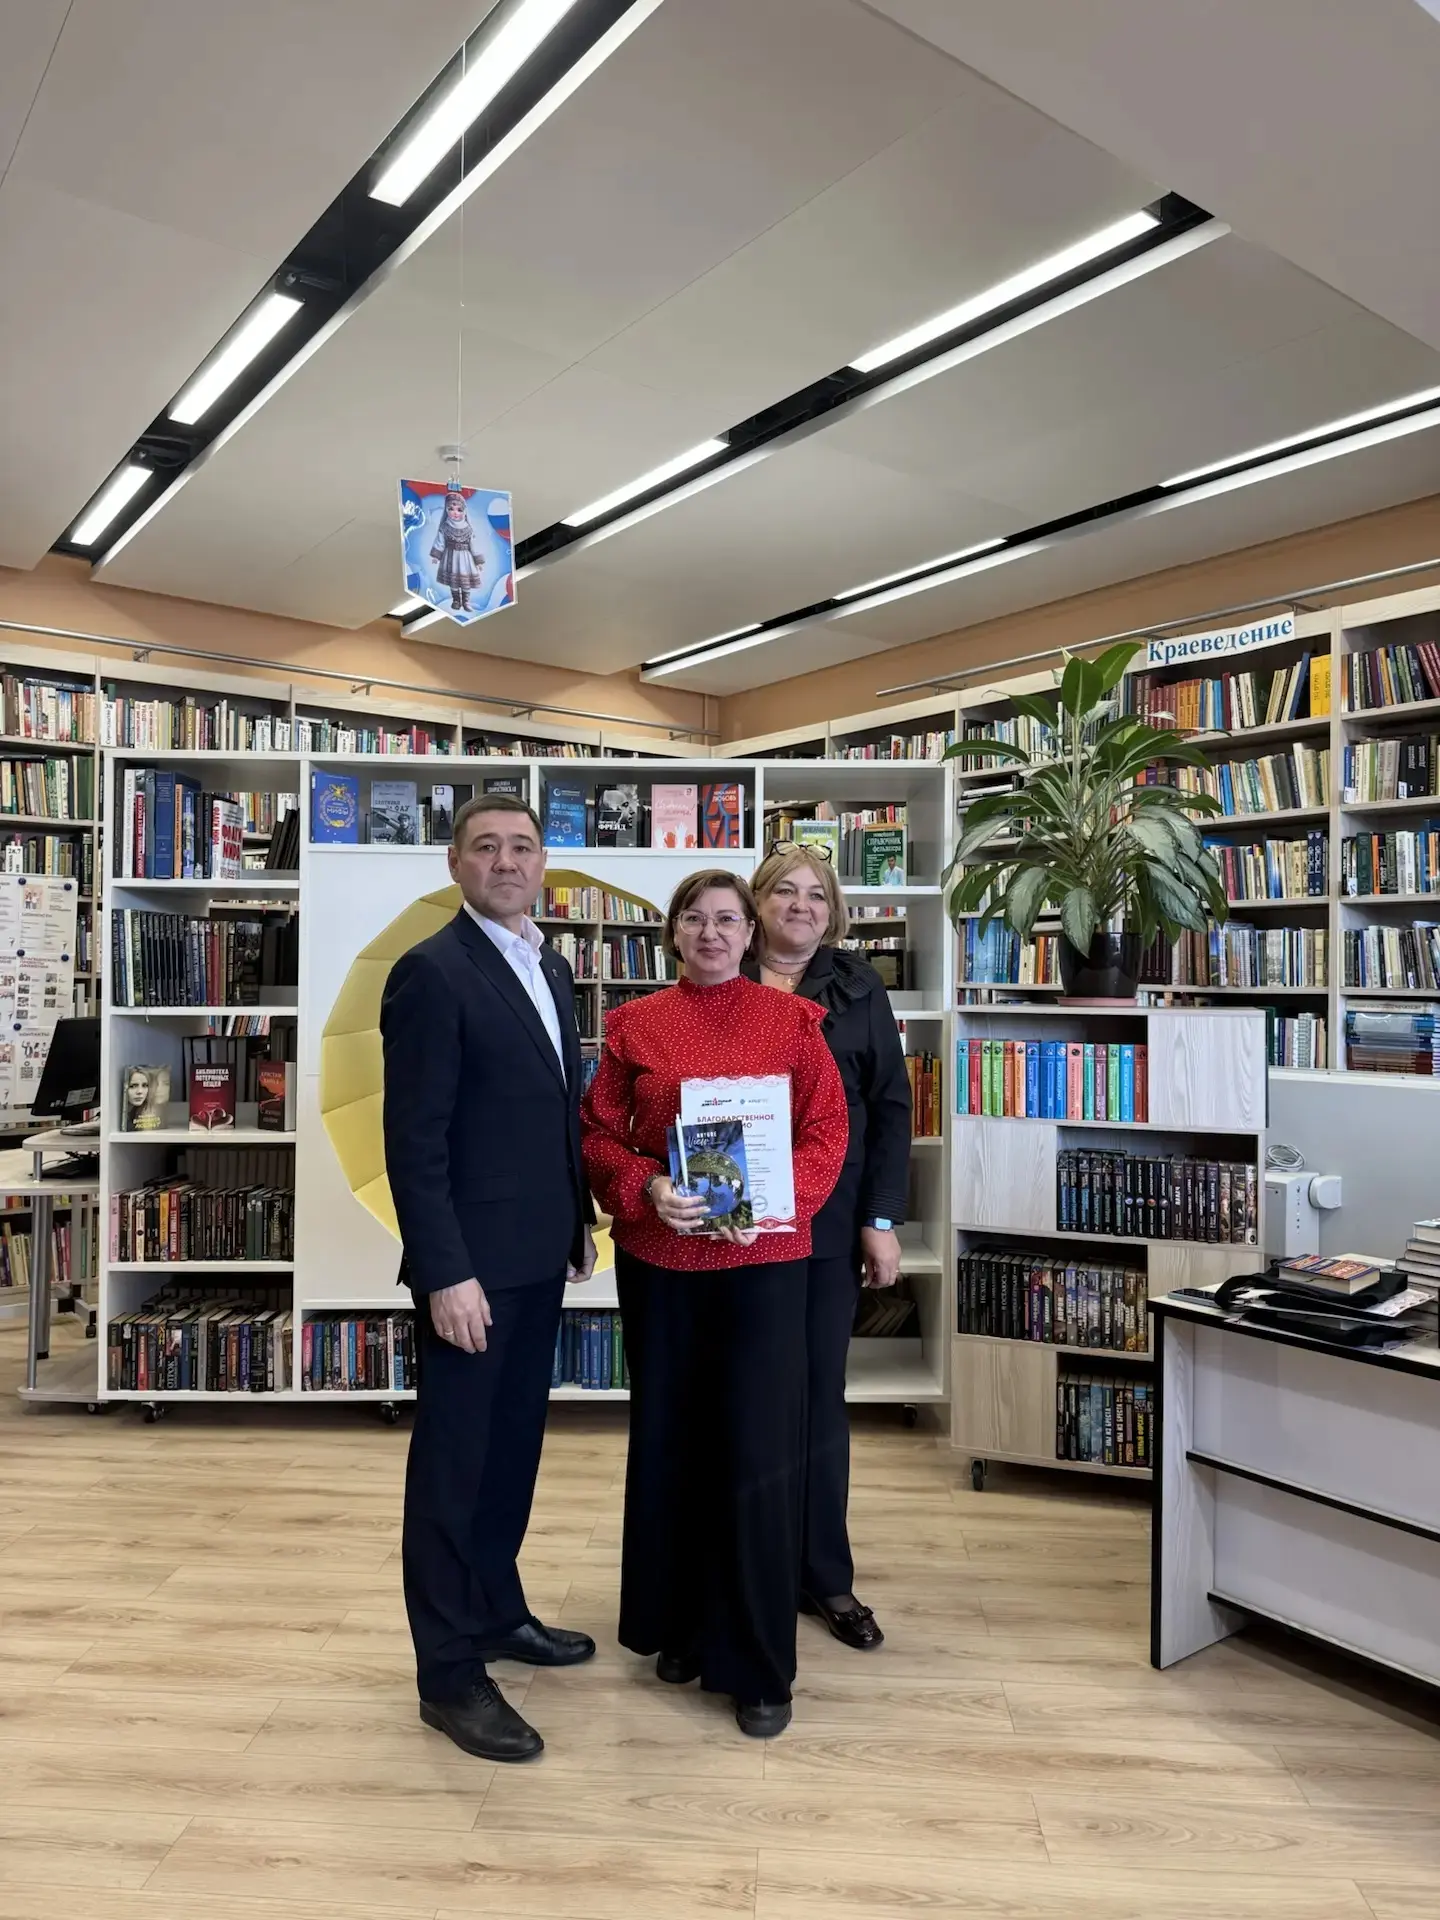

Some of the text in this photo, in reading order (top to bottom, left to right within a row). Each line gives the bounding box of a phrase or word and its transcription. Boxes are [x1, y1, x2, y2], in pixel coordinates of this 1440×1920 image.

[1148, 616, 1293, 664] Краеведение
[712, 795, 737, 803] ЛЮБОВЬ
[326, 807, 349, 815] МИФЫ
[598, 823, 627, 832] ФРЕЙД
[866, 837, 901, 846] СПРАВОЧНИК
[222, 840, 241, 861] МИРА
[202, 1080, 221, 1088] ВЕЩЕЙ
[697, 1114, 775, 1123] БЛАГОДАРСТВЕННОЕ
[167, 1360, 175, 1388] ОТРОК
